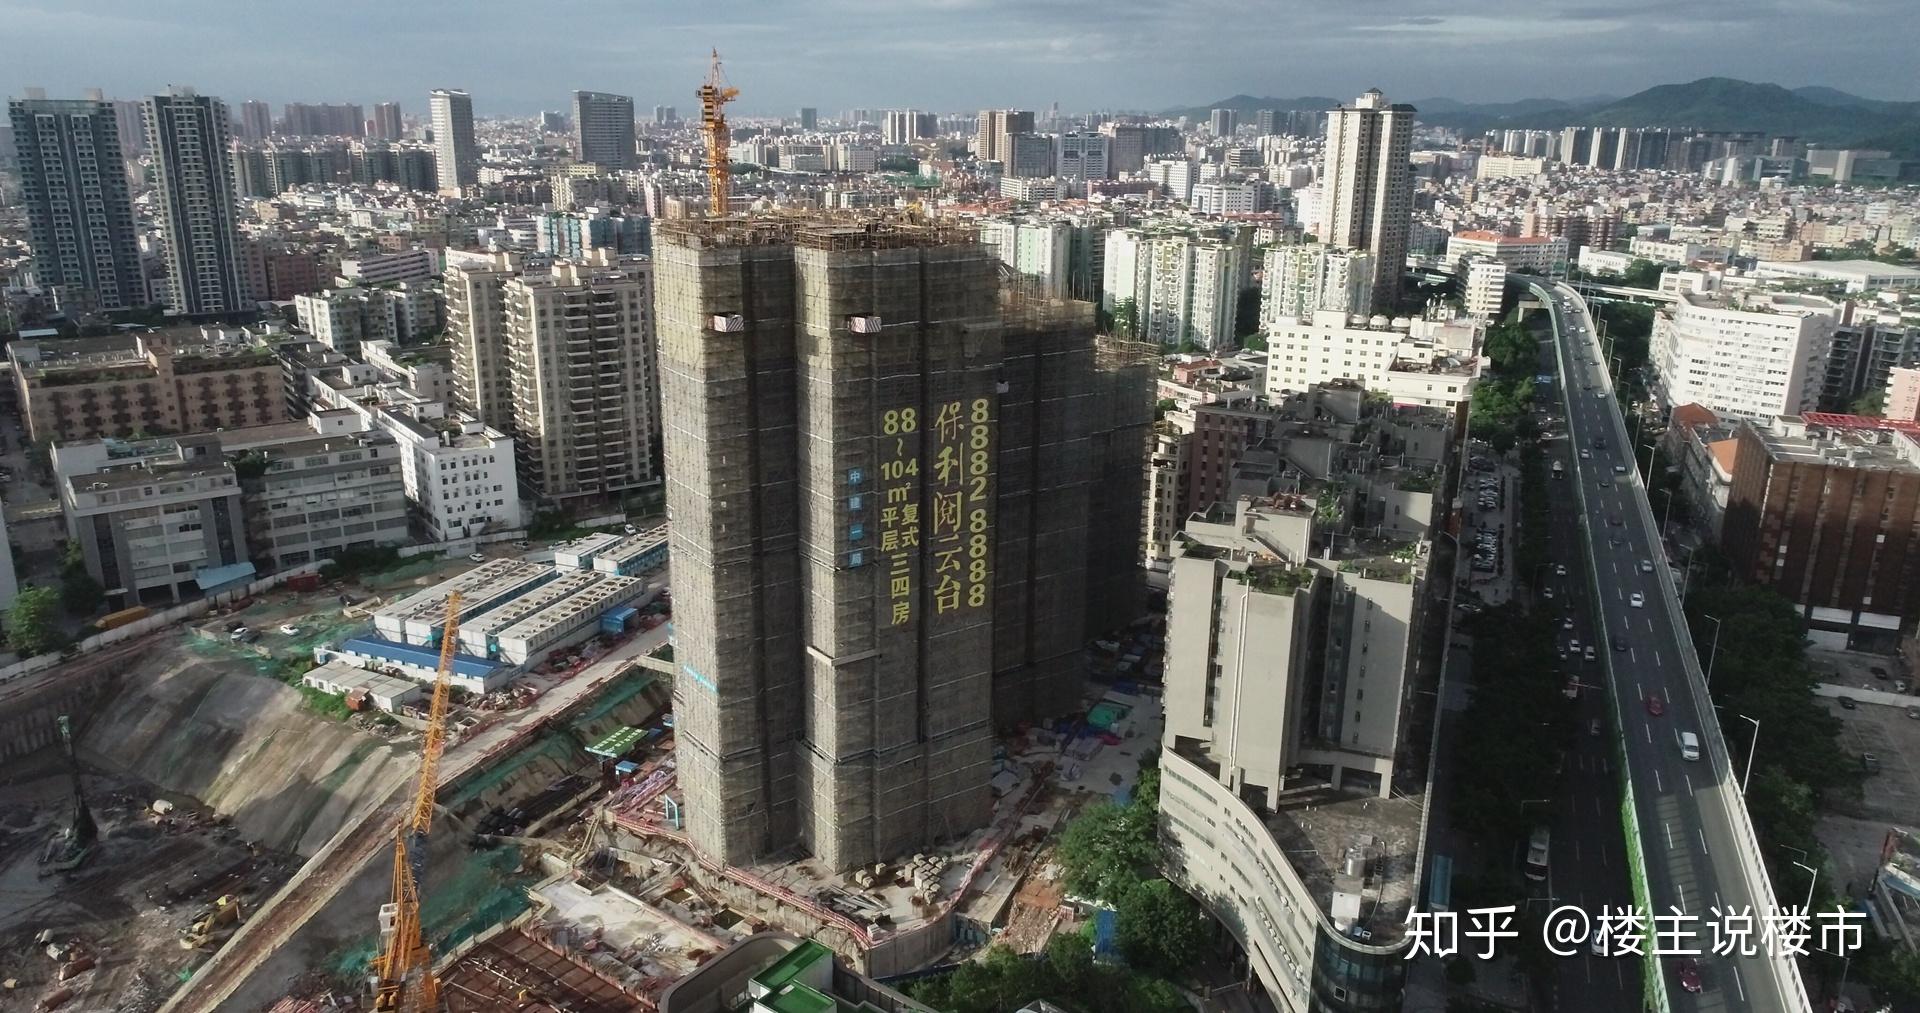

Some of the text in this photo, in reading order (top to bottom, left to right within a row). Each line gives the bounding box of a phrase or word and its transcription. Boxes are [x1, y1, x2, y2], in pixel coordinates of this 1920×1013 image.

[884, 408, 916, 435] 88
[881, 458, 919, 480] 104
[891, 553, 910, 625] 三四房
